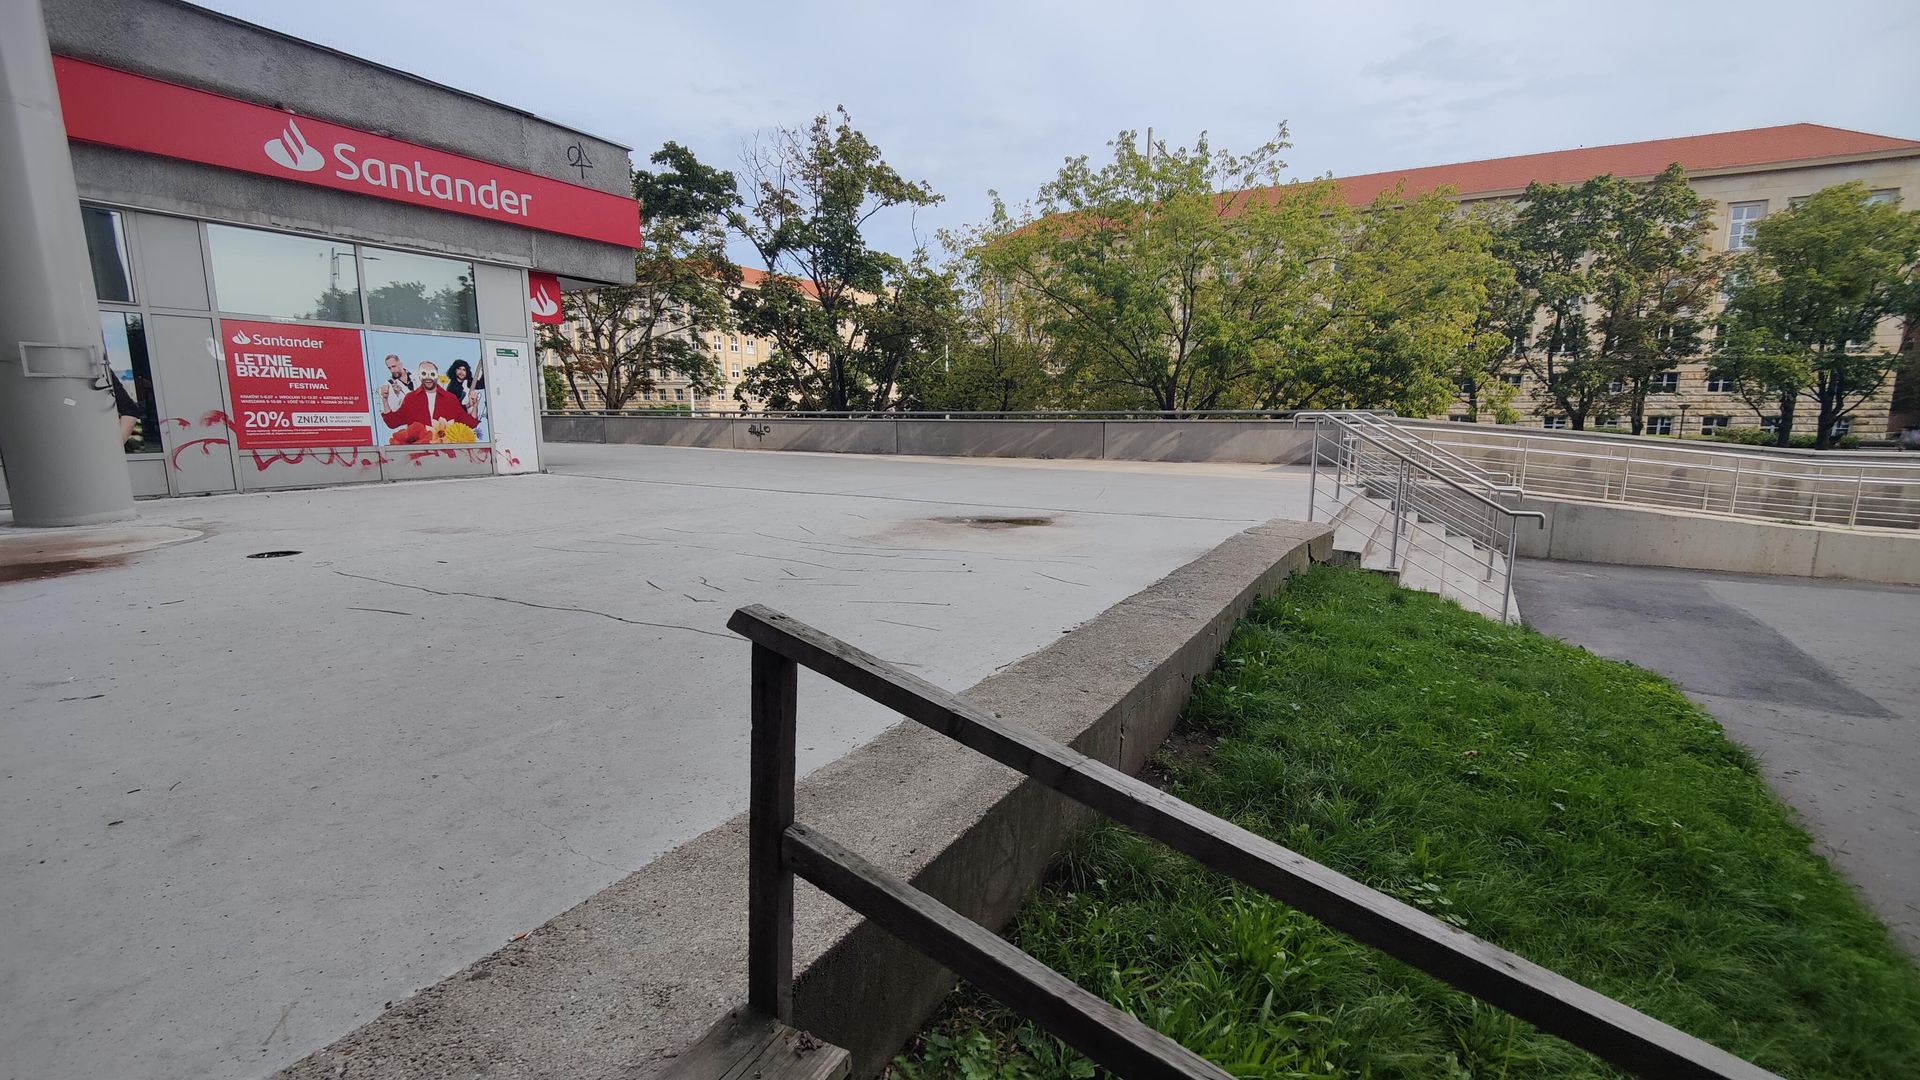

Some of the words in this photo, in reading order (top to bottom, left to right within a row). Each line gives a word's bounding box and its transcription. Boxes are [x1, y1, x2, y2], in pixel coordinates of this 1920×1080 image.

[333, 143, 532, 217] Santander
[253, 334, 323, 348] Santander
[234, 353, 292, 366] LETNIE
[236, 366, 327, 379] BRZMIENIA
[244, 411, 290, 428] 20%
[297, 414, 329, 424] ZNIŻKI
